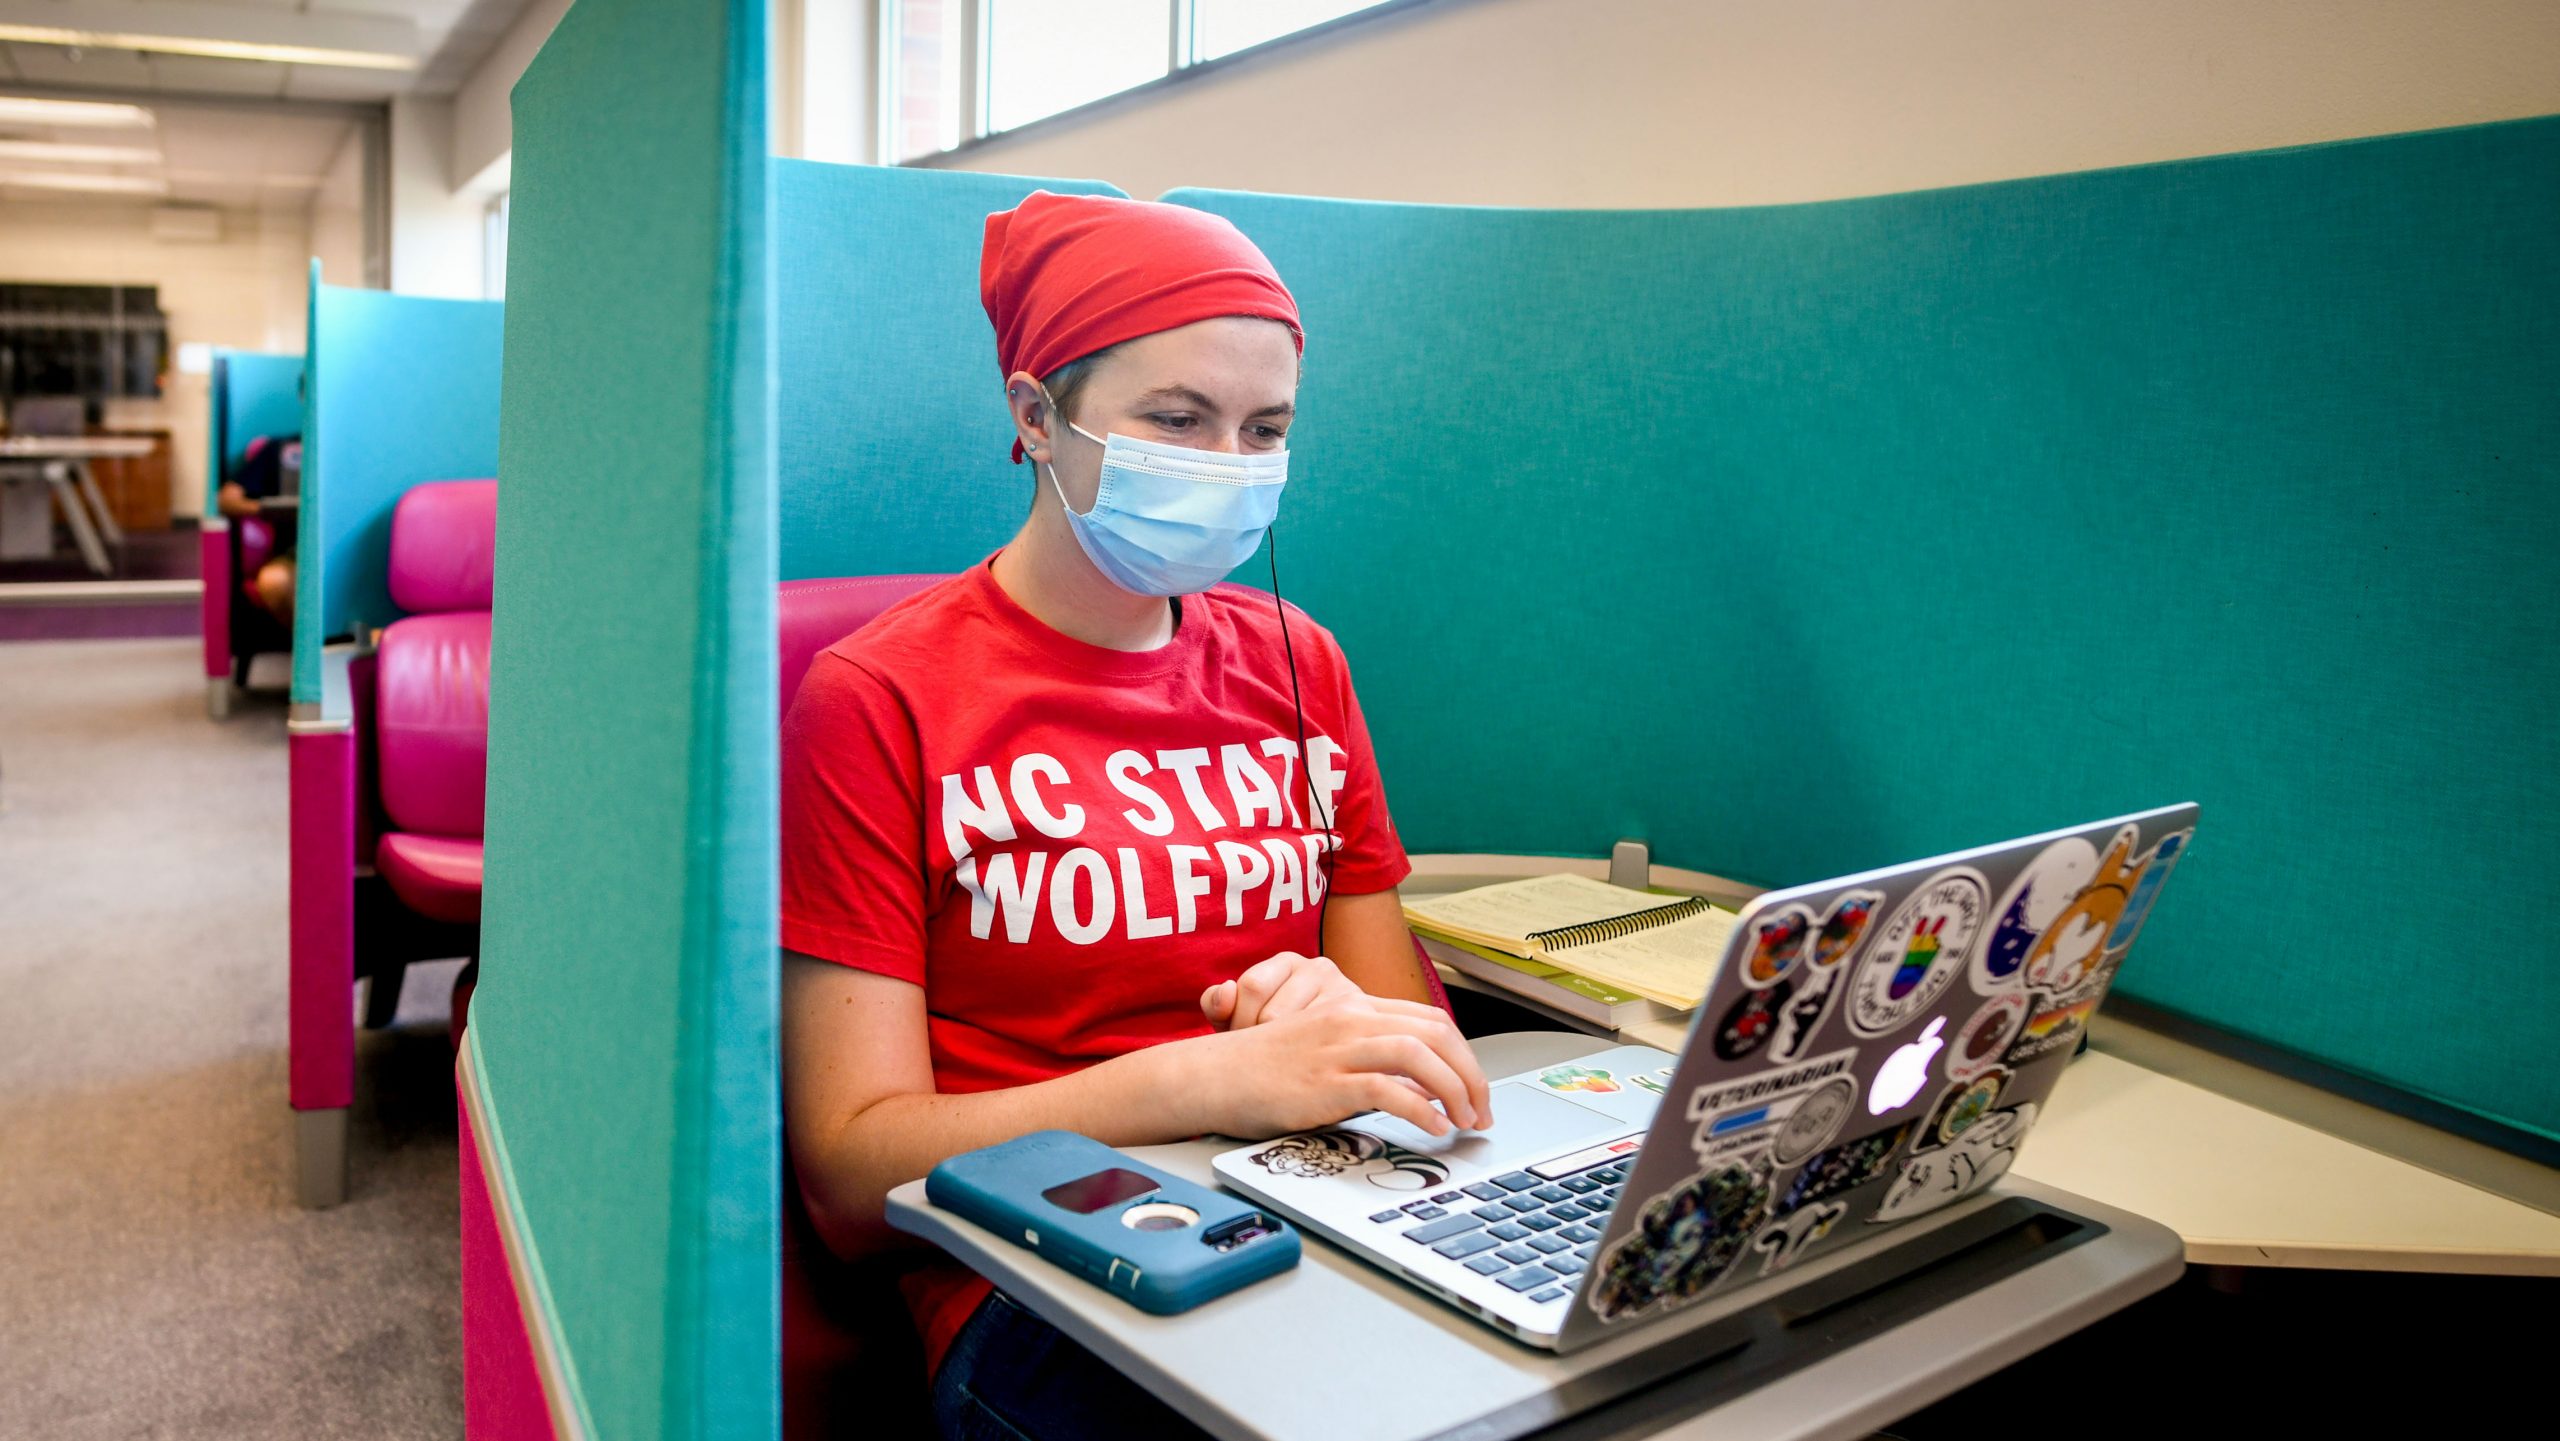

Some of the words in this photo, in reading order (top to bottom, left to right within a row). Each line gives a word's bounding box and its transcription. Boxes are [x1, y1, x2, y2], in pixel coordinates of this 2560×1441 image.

[941, 752, 1086, 862] NC
[1105, 735, 1347, 837] STATE
[956, 834, 1344, 946] WOLFPAC
[1698, 1059, 1845, 1111] VETERINARIAN
